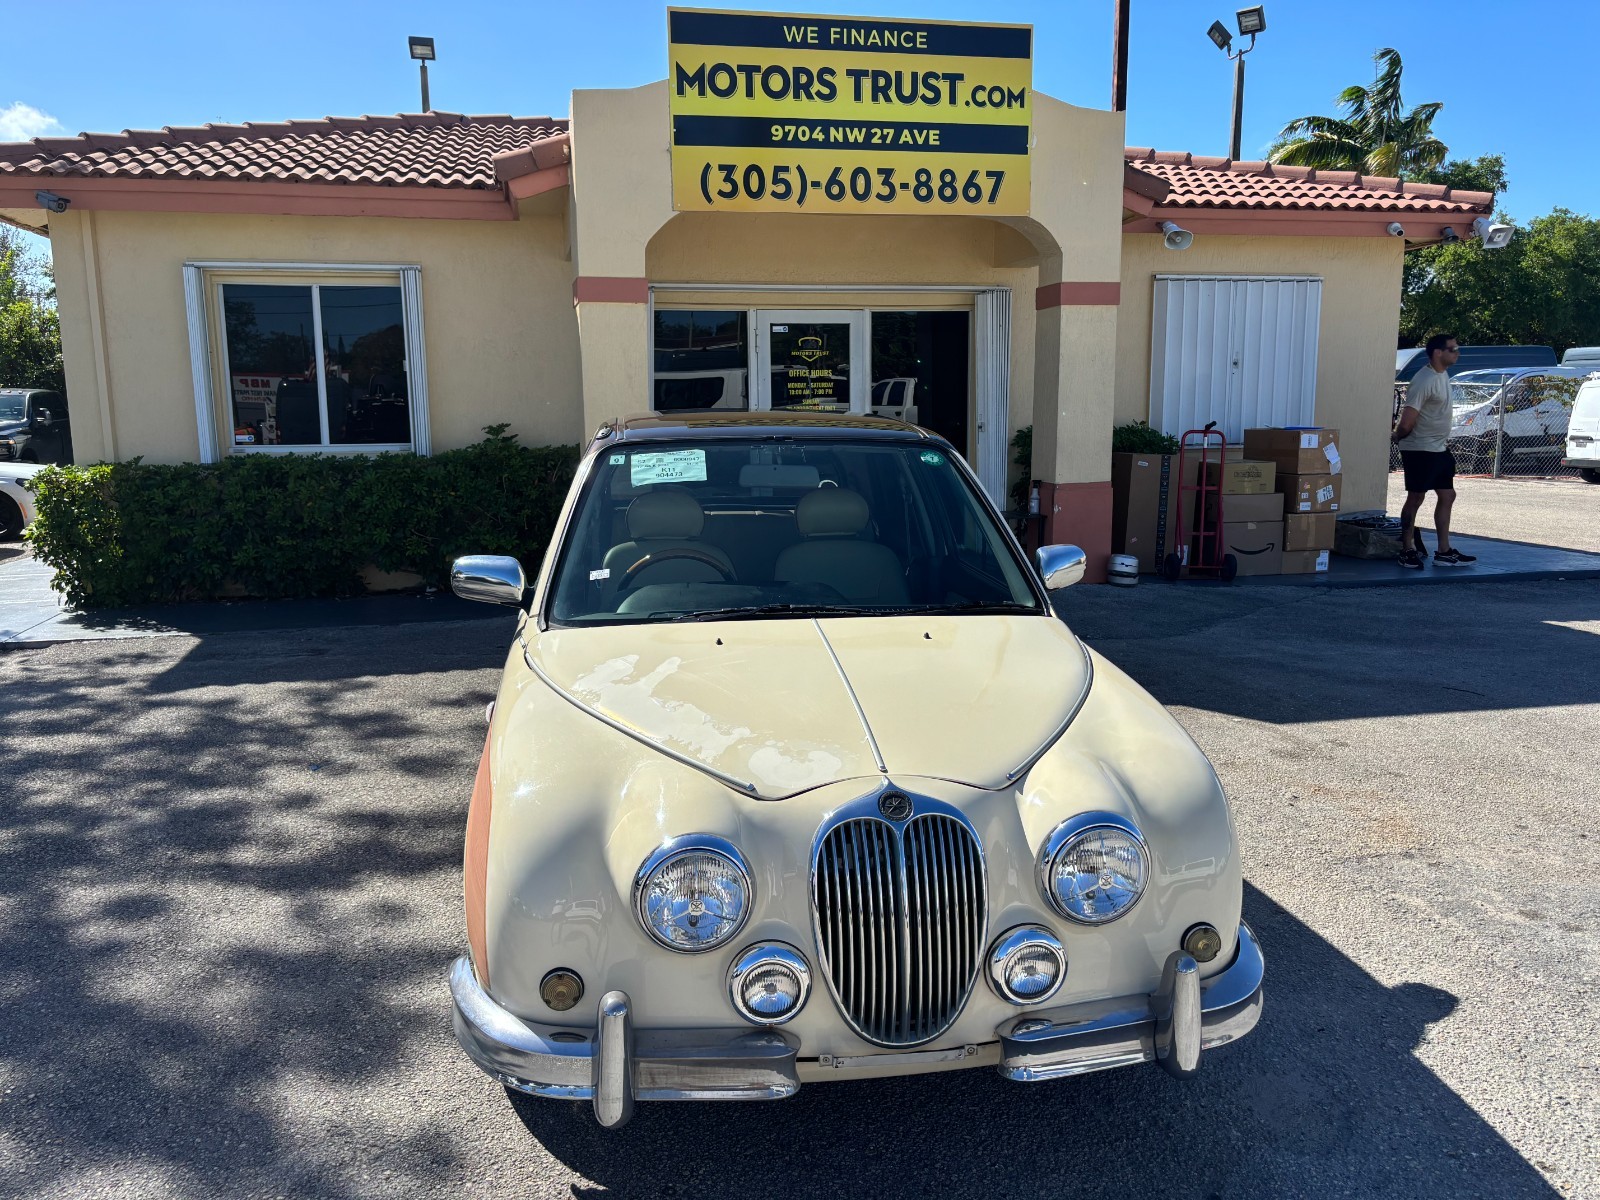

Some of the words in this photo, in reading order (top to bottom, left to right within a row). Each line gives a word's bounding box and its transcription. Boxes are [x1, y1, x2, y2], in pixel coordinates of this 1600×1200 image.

[783, 25, 819, 44] WE
[830, 27, 928, 49] FINANCE
[675, 61, 838, 103] MOTORS
[770, 124, 826, 142] 9704
[829, 126, 867, 143] NW
[870, 128, 896, 144] 27
[898, 128, 941, 145] AVE
[700, 161, 1006, 208] (305)-603-8867
